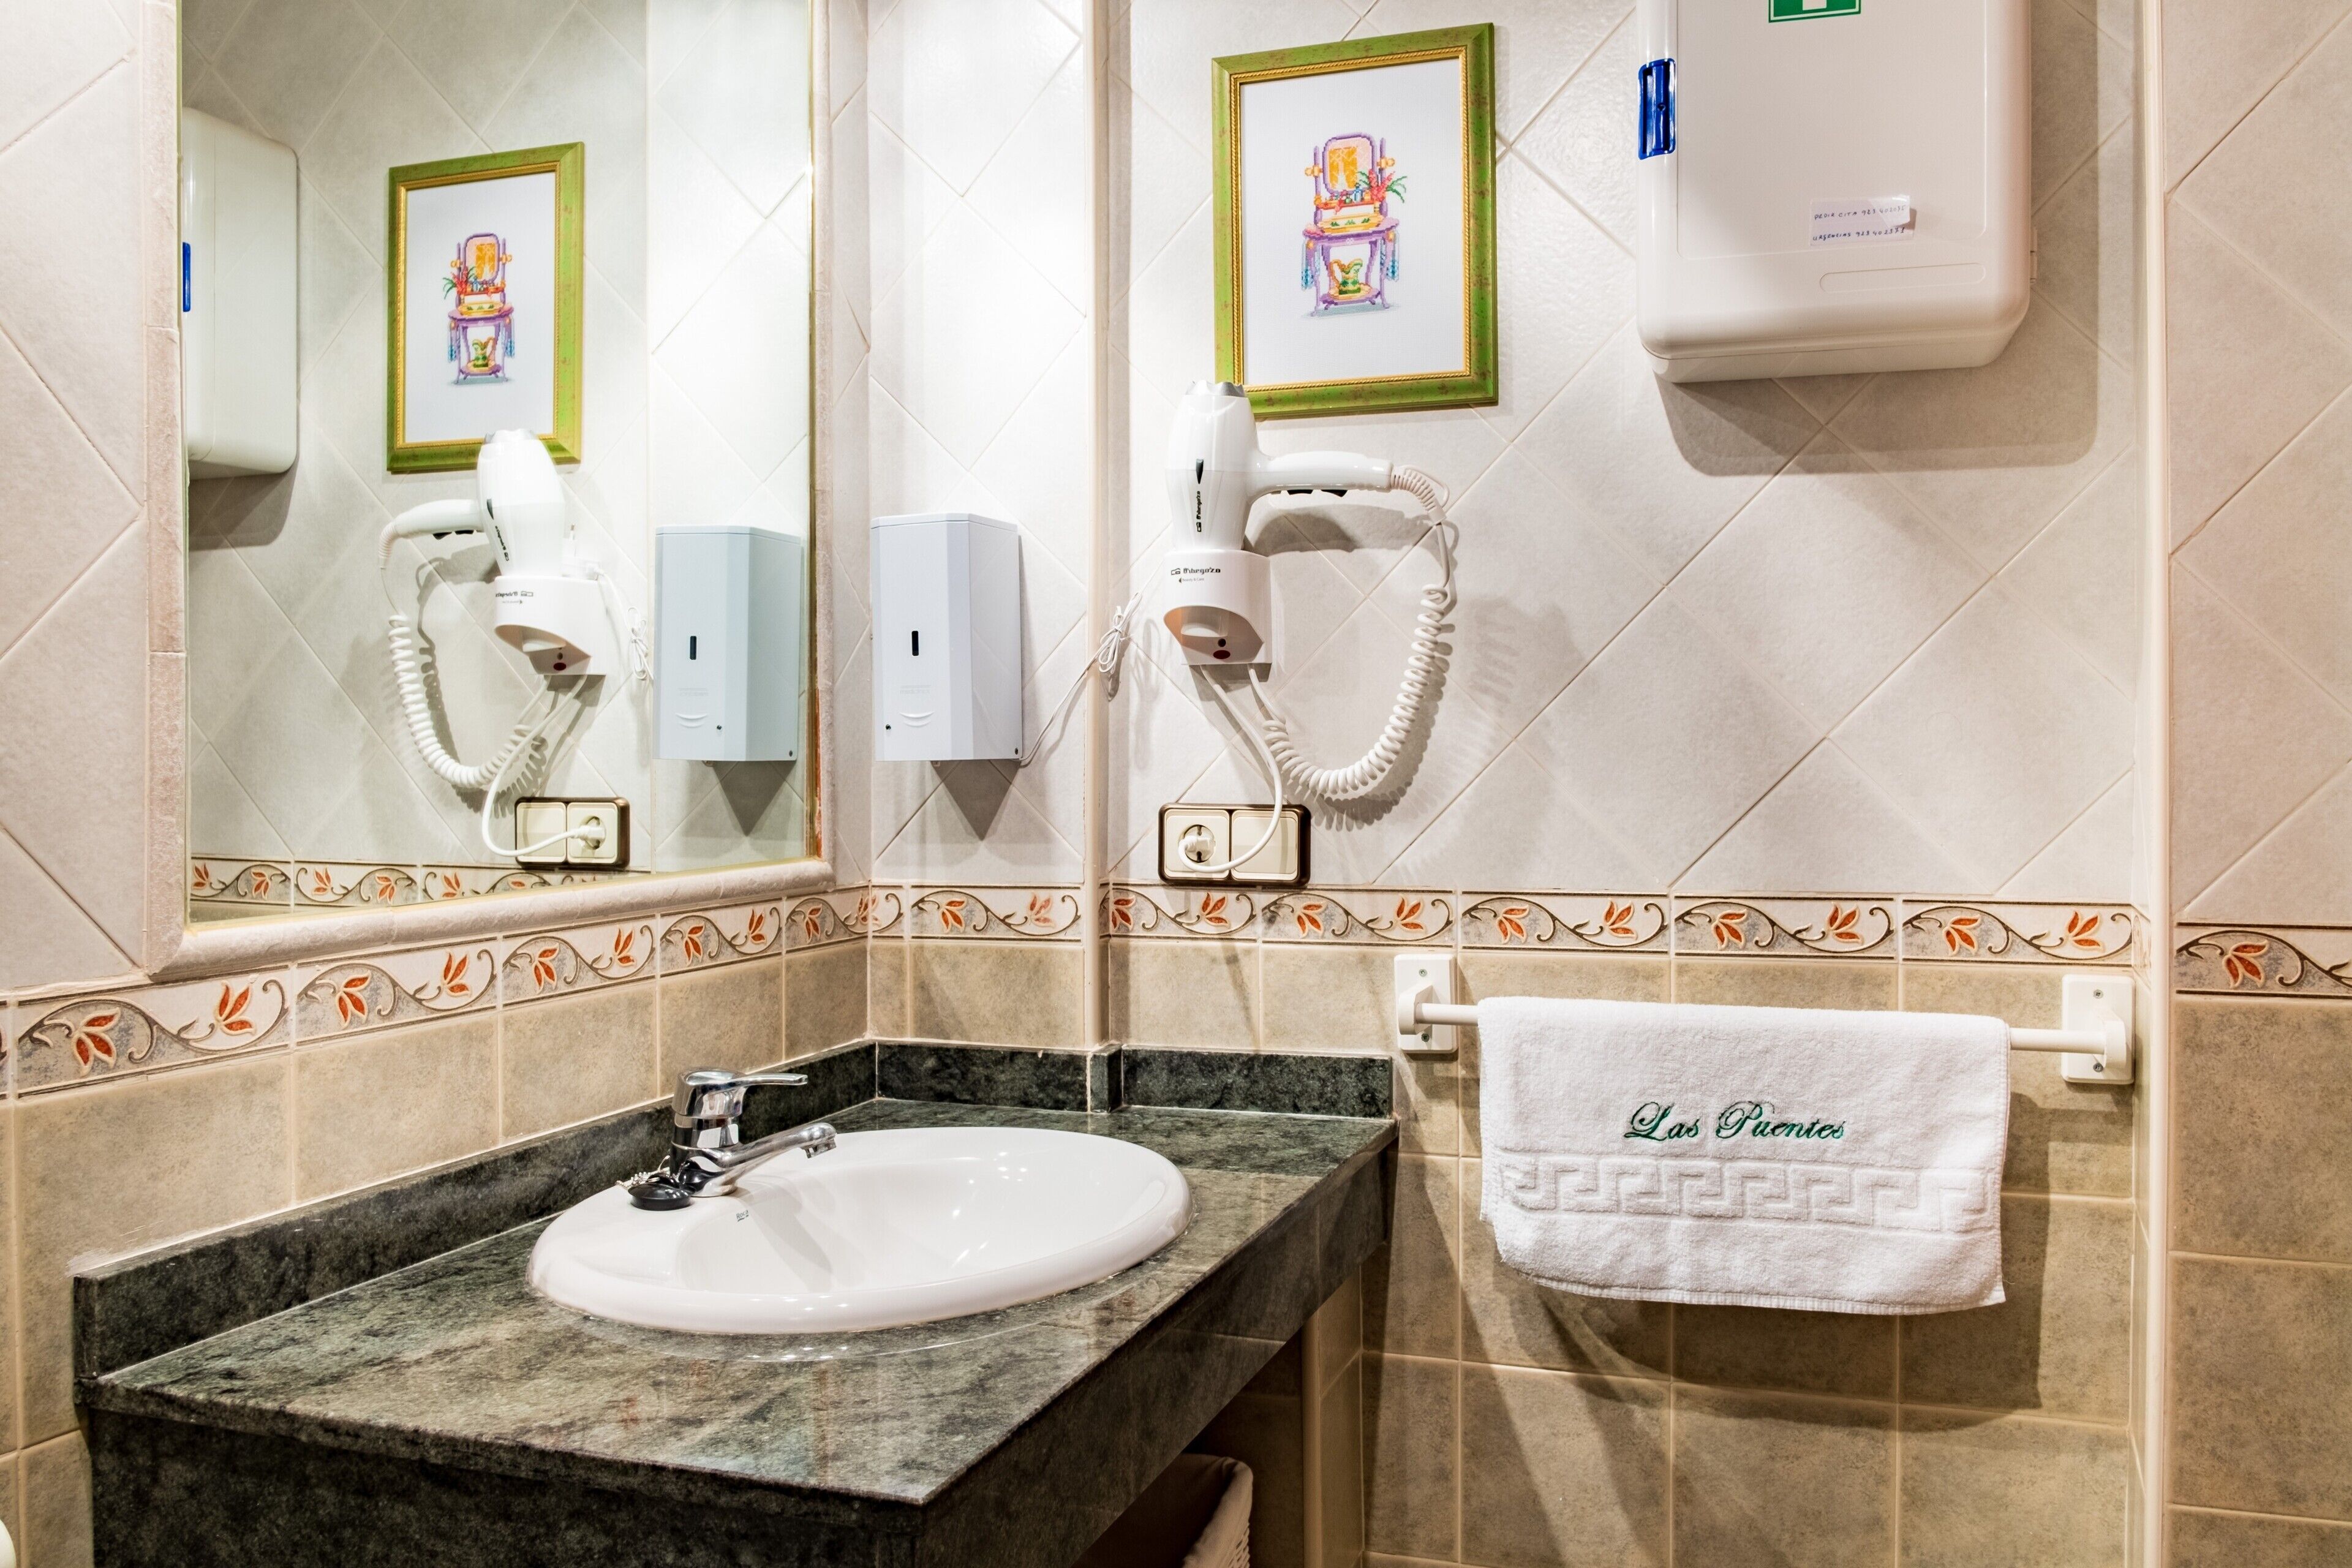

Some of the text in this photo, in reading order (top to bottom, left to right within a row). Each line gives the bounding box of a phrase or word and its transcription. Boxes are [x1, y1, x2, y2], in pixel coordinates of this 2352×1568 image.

[1813, 232, 1851, 241] URGENCIAS
[1872, 227, 1905, 236] 402371
[1624, 1101, 1847, 1141] Las Puentes
[736, 1210, 748, 1219] Roca
